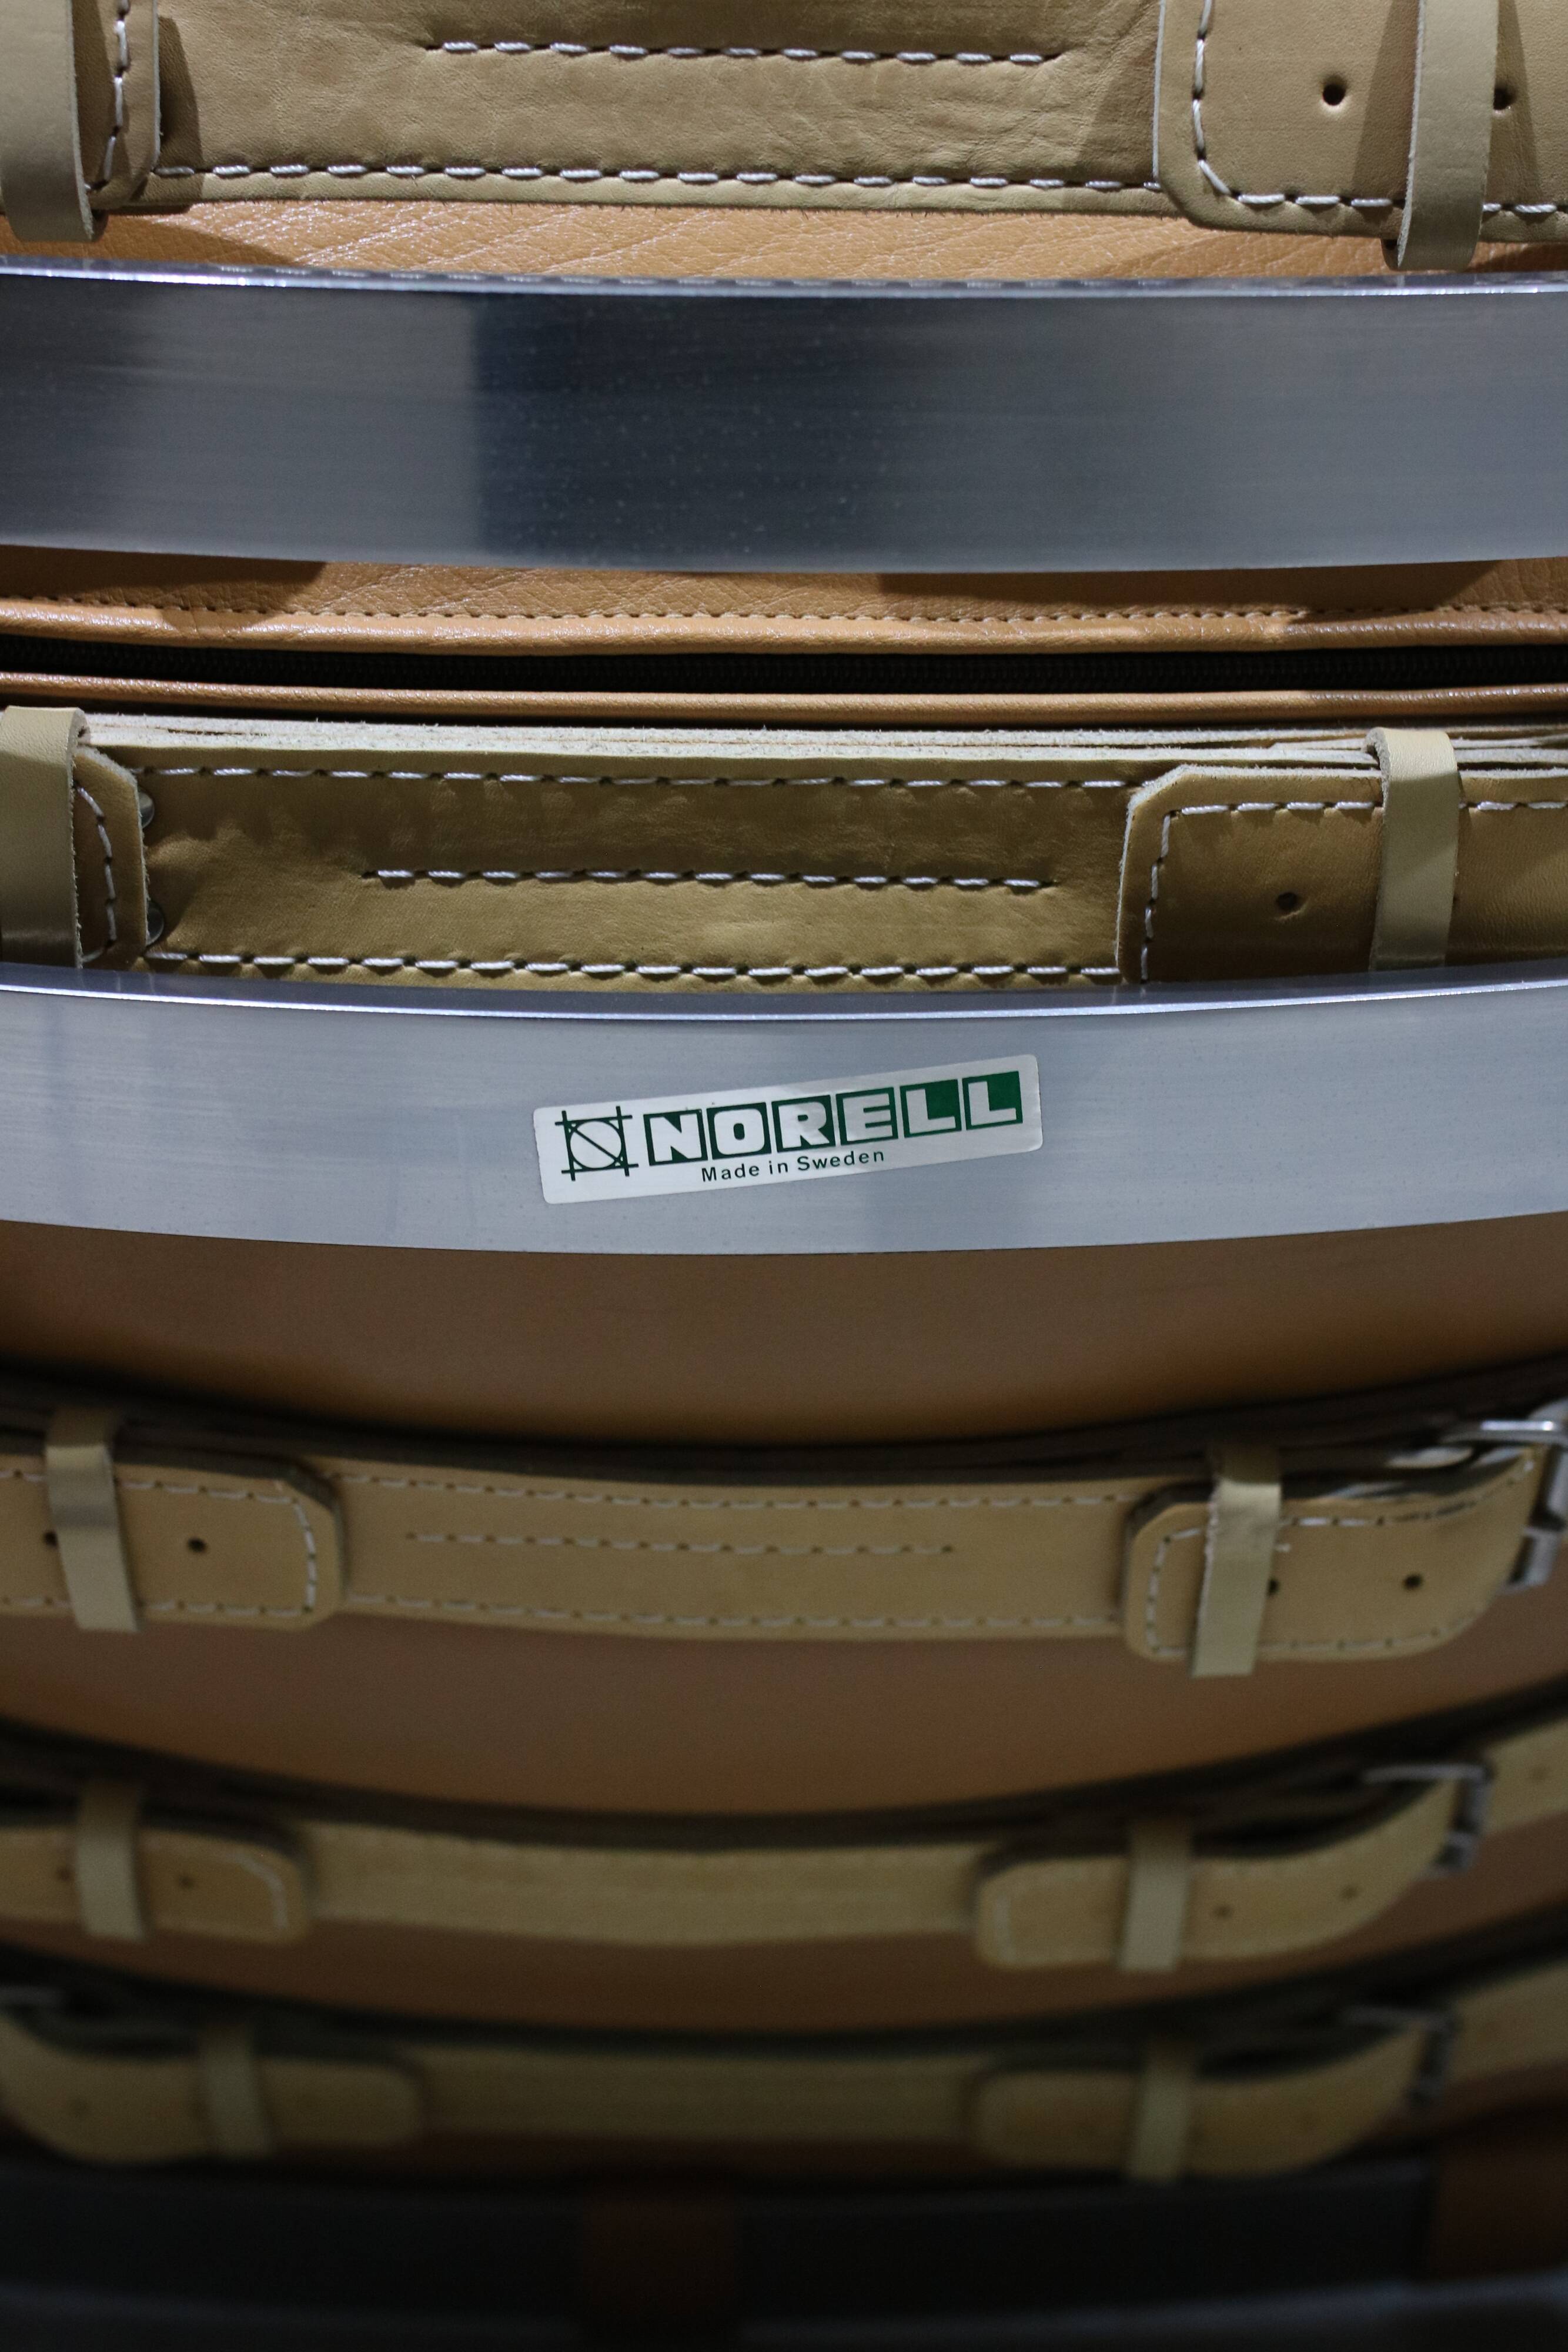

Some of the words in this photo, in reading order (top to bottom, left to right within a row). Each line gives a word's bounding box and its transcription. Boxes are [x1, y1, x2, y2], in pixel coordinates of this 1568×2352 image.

[647, 1075, 1019, 1164] NORELL
[701, 1164, 760, 1182] Made
[769, 1160, 788, 1174] in
[797, 1151, 885, 1171] Sweden
